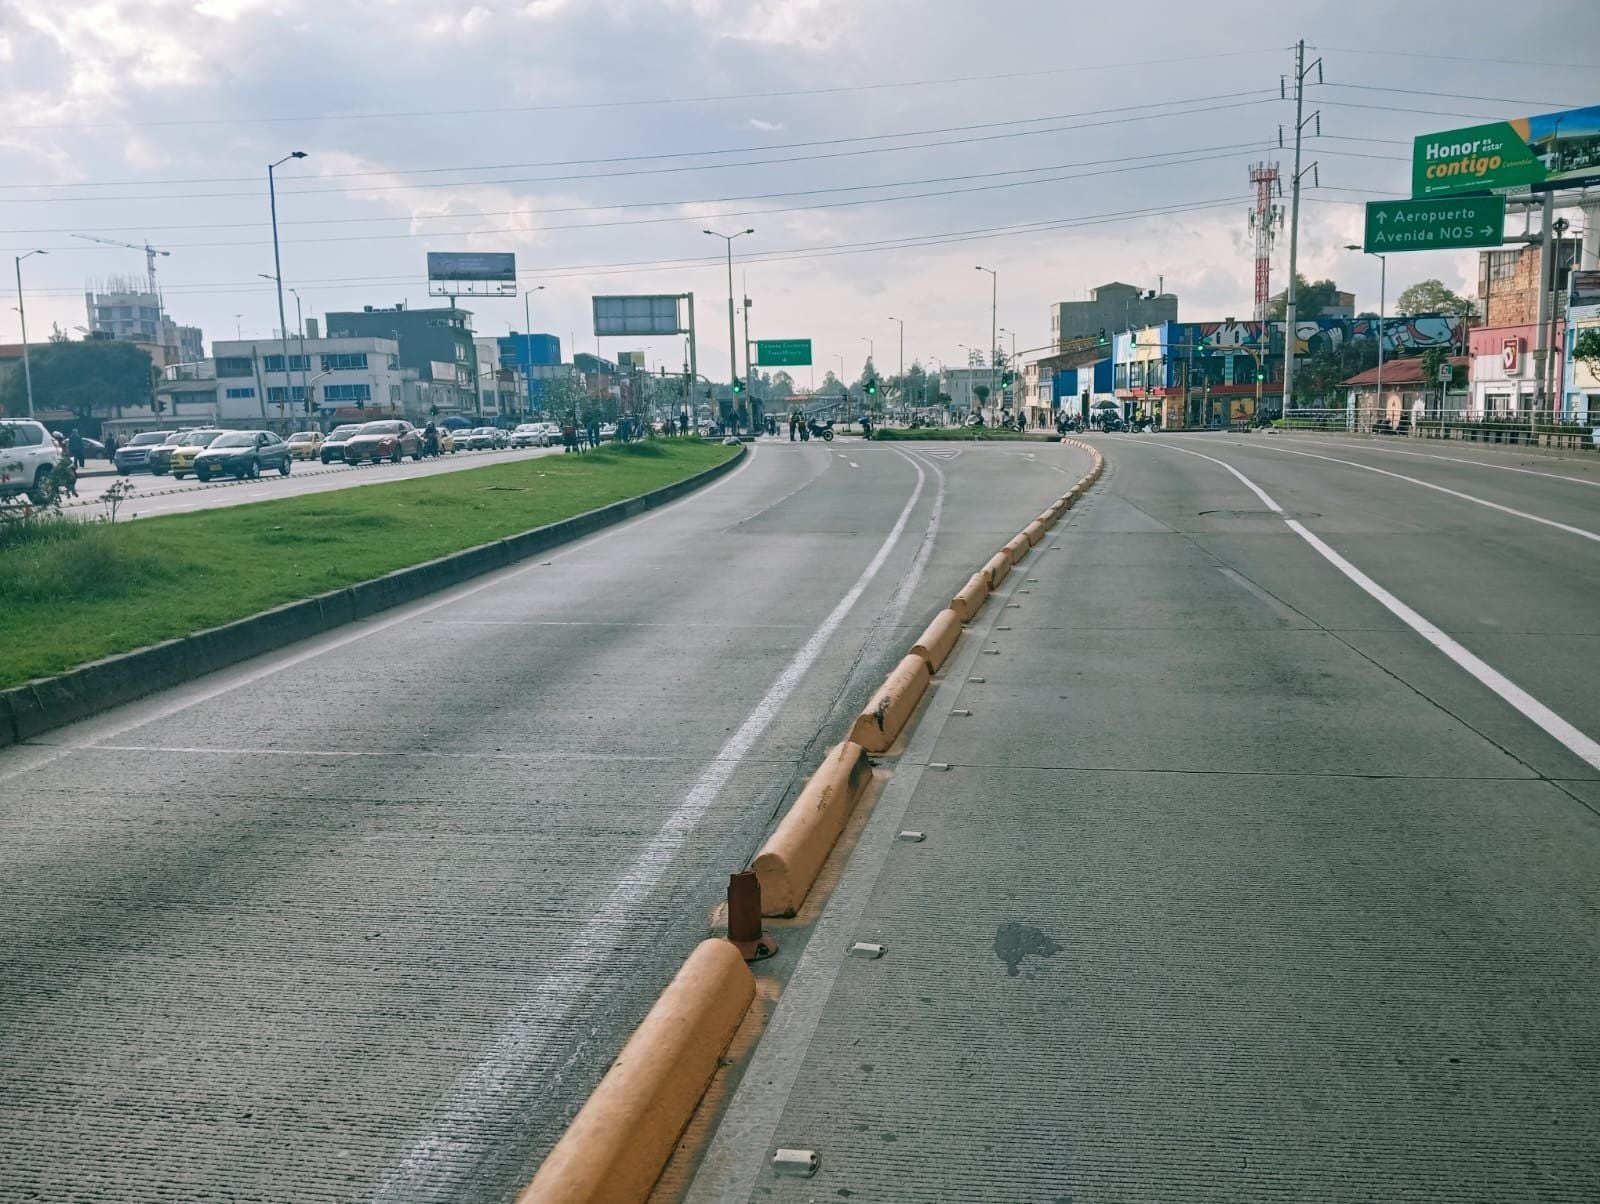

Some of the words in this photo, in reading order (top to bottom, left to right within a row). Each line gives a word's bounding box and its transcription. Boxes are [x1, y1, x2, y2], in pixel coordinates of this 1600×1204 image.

[1426, 141, 1480, 160] Honor
[1482, 143, 1503, 151] estar
[1426, 154, 1502, 179] contigo
[1393, 208, 1475, 224] Aeropuerto
[1375, 229, 1434, 243] Avenida
[1440, 226, 1474, 240] NQS
